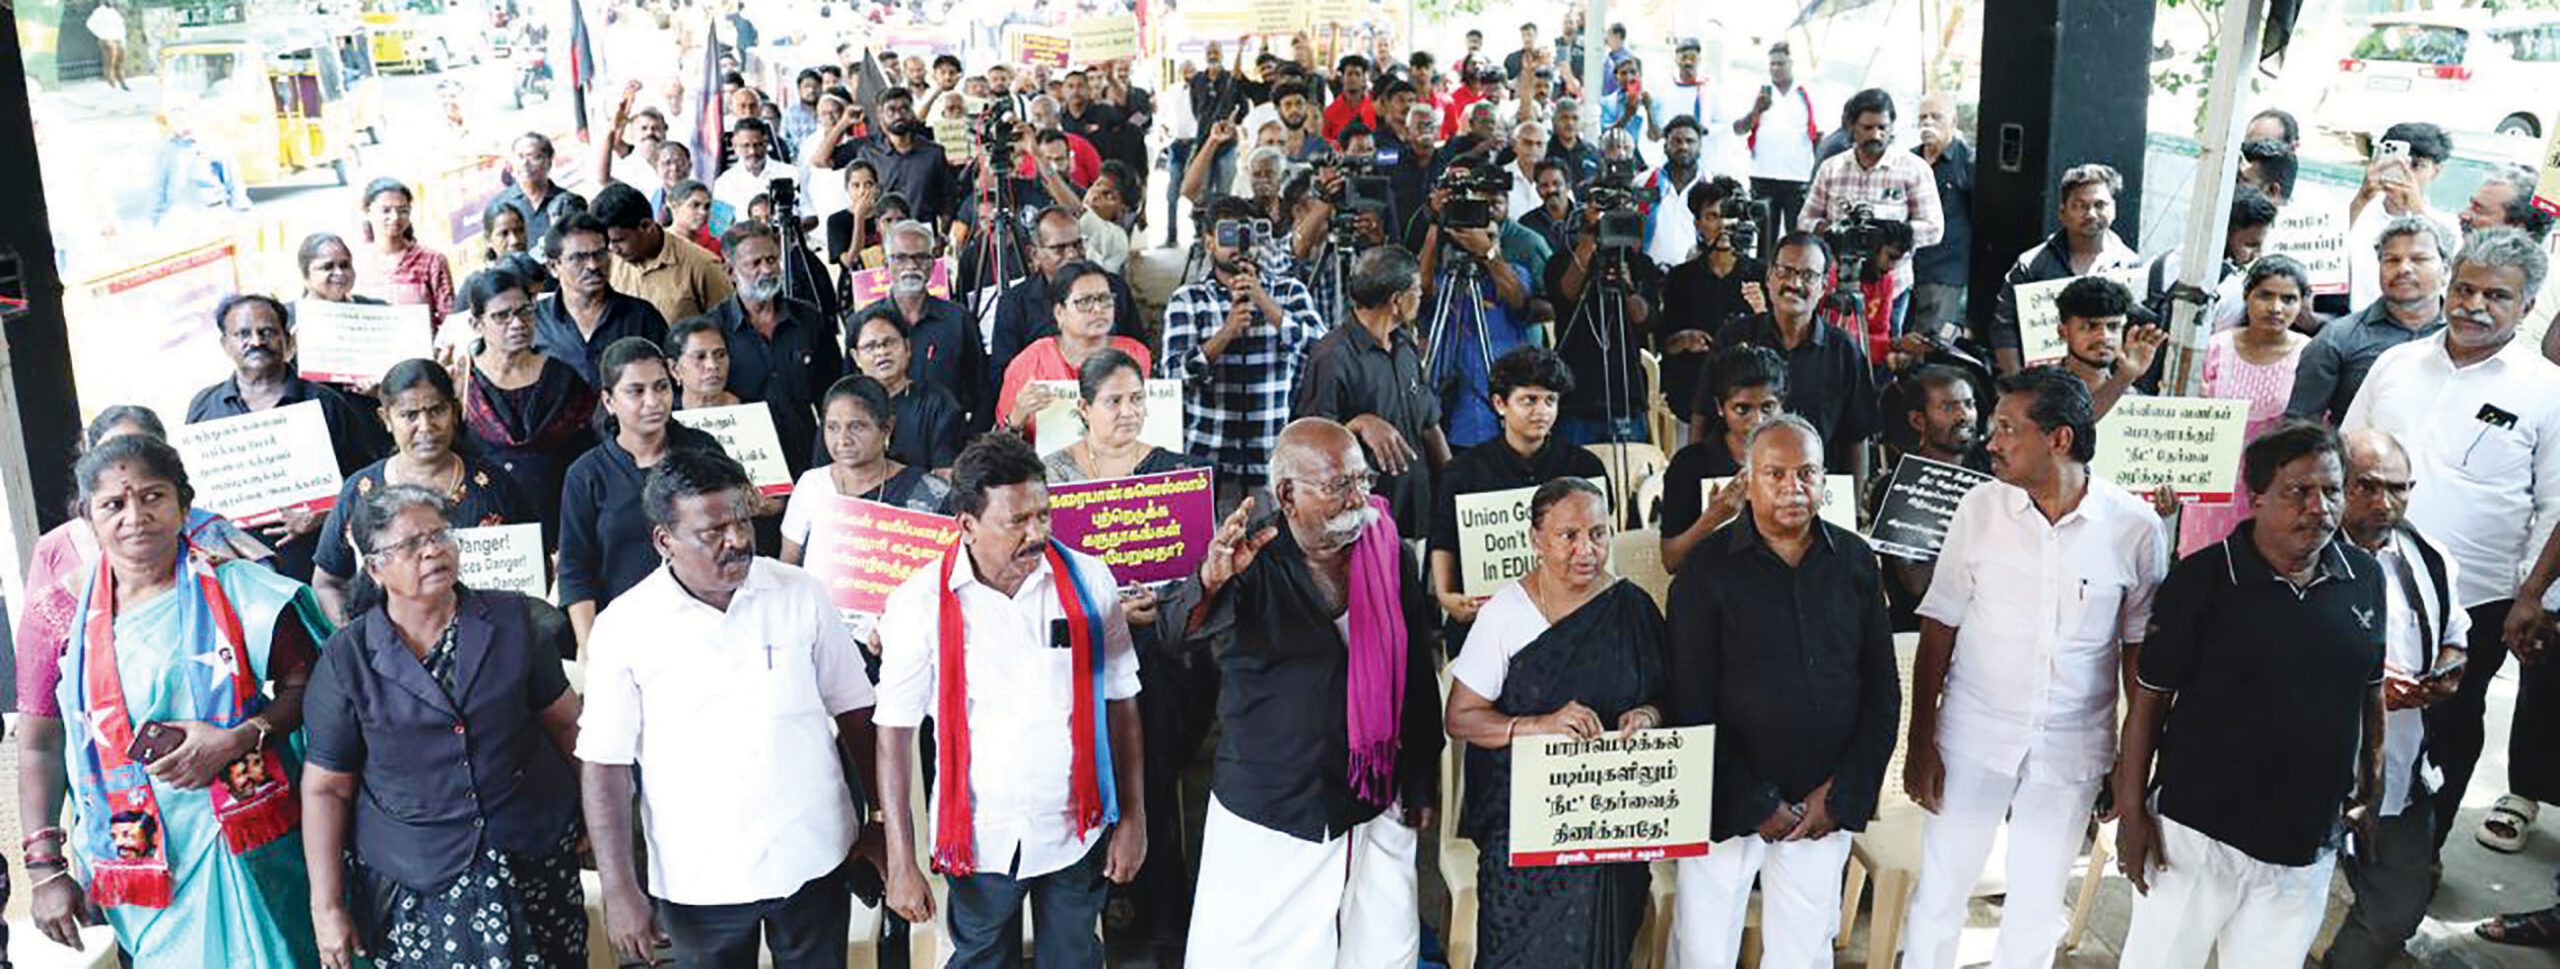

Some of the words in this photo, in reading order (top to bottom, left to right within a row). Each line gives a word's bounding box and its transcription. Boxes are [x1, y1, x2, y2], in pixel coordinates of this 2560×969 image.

[2123, 425, 2217, 443] பொருளாக்கும்
[1092, 500, 1170, 528] புற்றெடுக்க
[1461, 507, 1509, 528] Union
[1513, 501, 1532, 521] Go
[1082, 519, 1182, 550] கருநாகங்கள்
[1485, 531, 1527, 552] Don't
[1097, 542, 1185, 567] யேறுவதா?
[1483, 561, 1498, 581] In
[1502, 556, 1543, 579] EDU
[1549, 759, 1678, 788] படிப்புகளிலும்
[1545, 794, 1585, 818] 'நீட்'
[1591, 789, 1680, 813] தேர்வைத்
[1552, 818, 1670, 846] திணிக்காதே!
